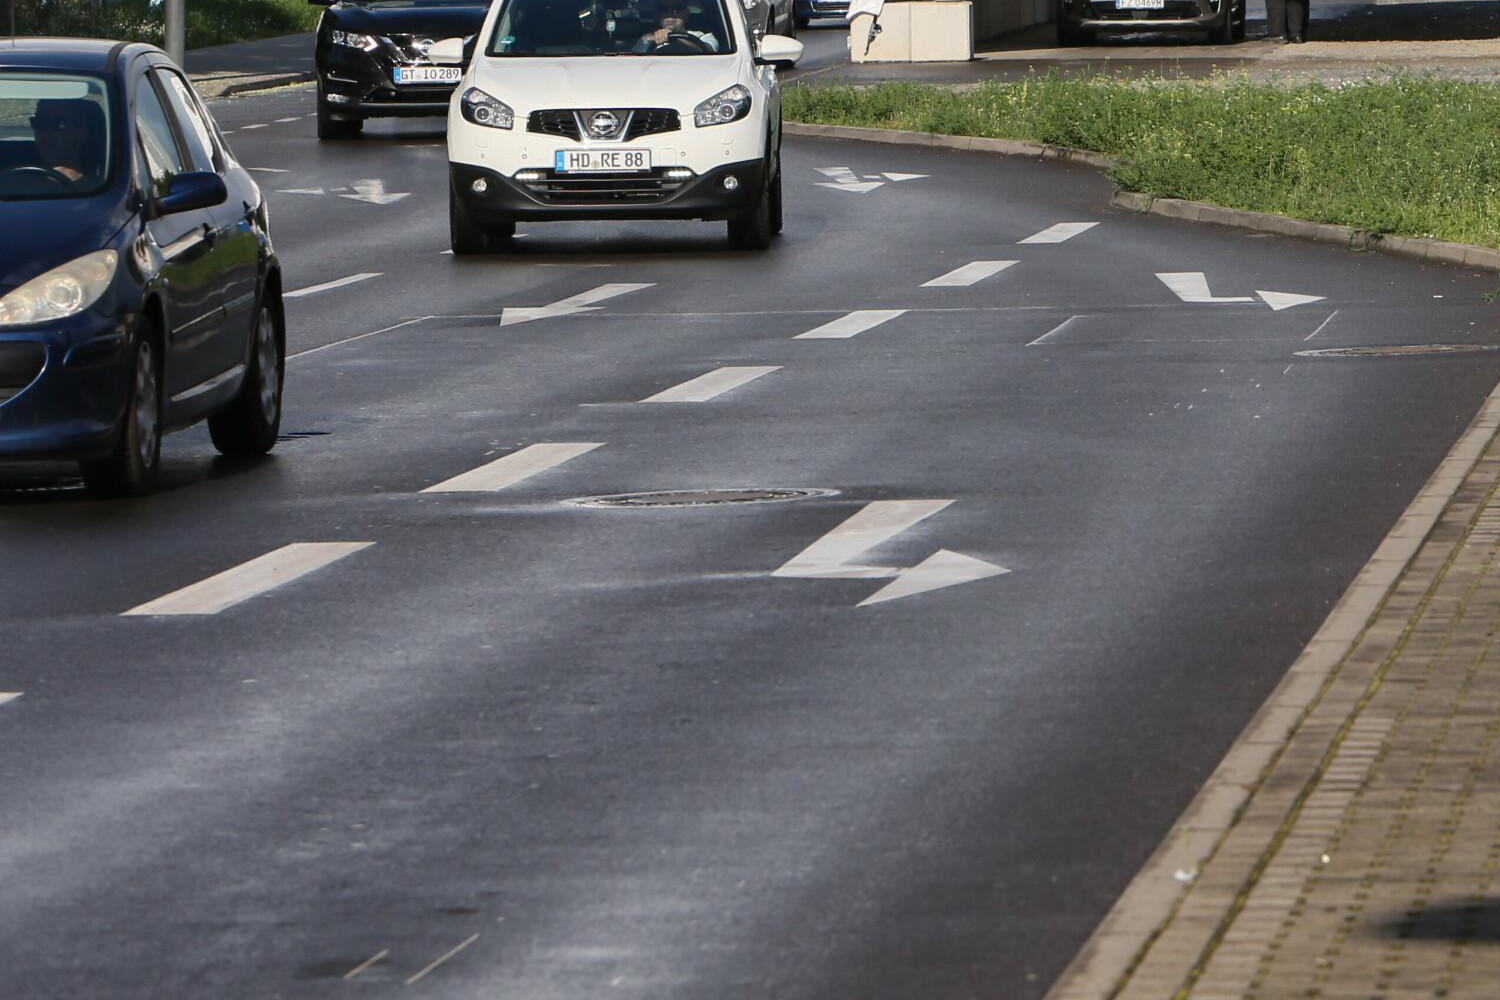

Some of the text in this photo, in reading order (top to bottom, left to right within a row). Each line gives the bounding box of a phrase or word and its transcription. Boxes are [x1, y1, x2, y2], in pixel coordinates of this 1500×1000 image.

[401, 69, 415, 80] GT
[439, 69, 459, 79] 289
[570, 152, 644, 168] HD RE 88
